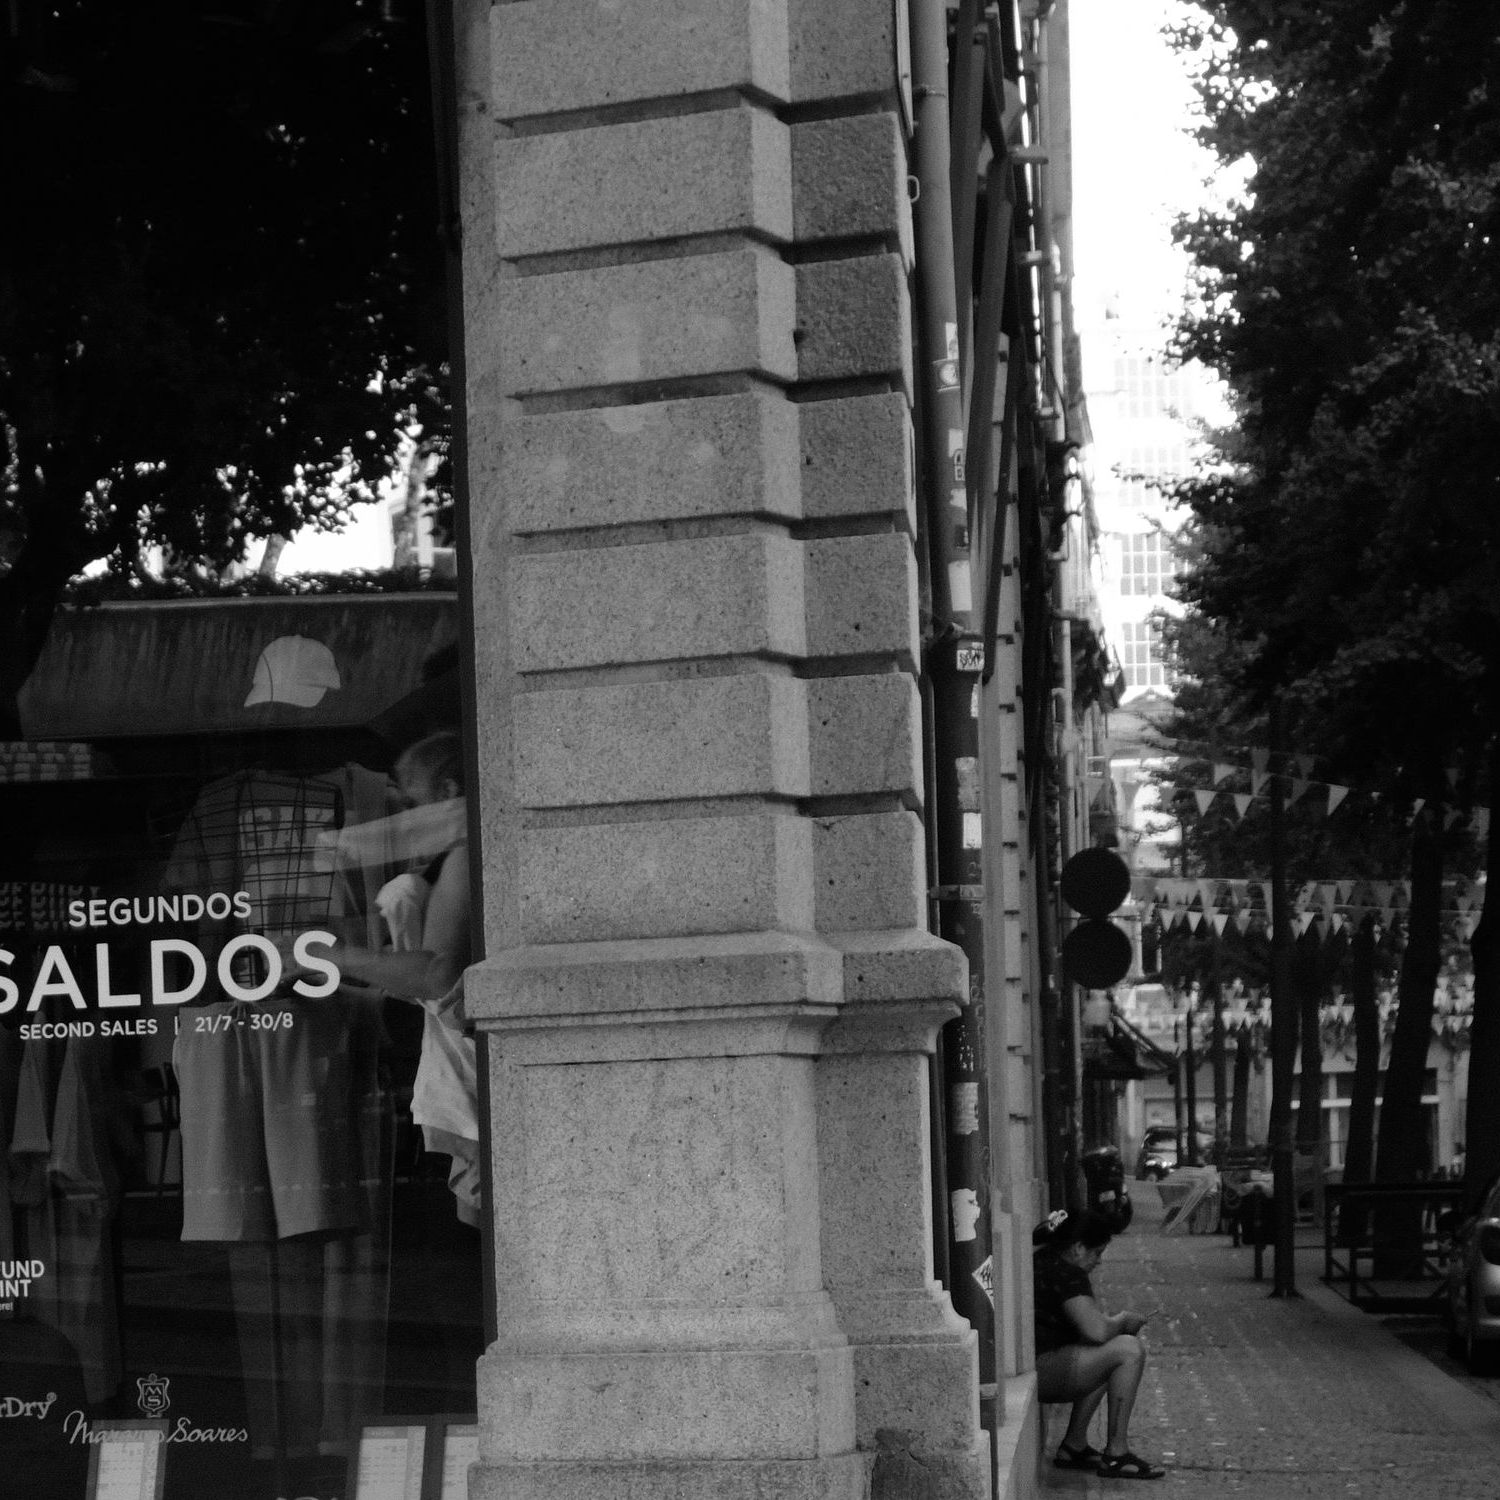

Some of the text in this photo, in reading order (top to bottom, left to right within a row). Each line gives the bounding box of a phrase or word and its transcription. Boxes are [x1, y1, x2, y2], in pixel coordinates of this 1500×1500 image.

[68, 891, 252, 927] SEGUNDOS
[19, 1021, 96, 1040] SECOND
[101, 1018, 158, 1037] SALES
[195, 1014, 232, 1034] 21/7
[250, 1011, 294, 1031] 30/8
[63, 1410, 248, 1445] Marqus Soares
